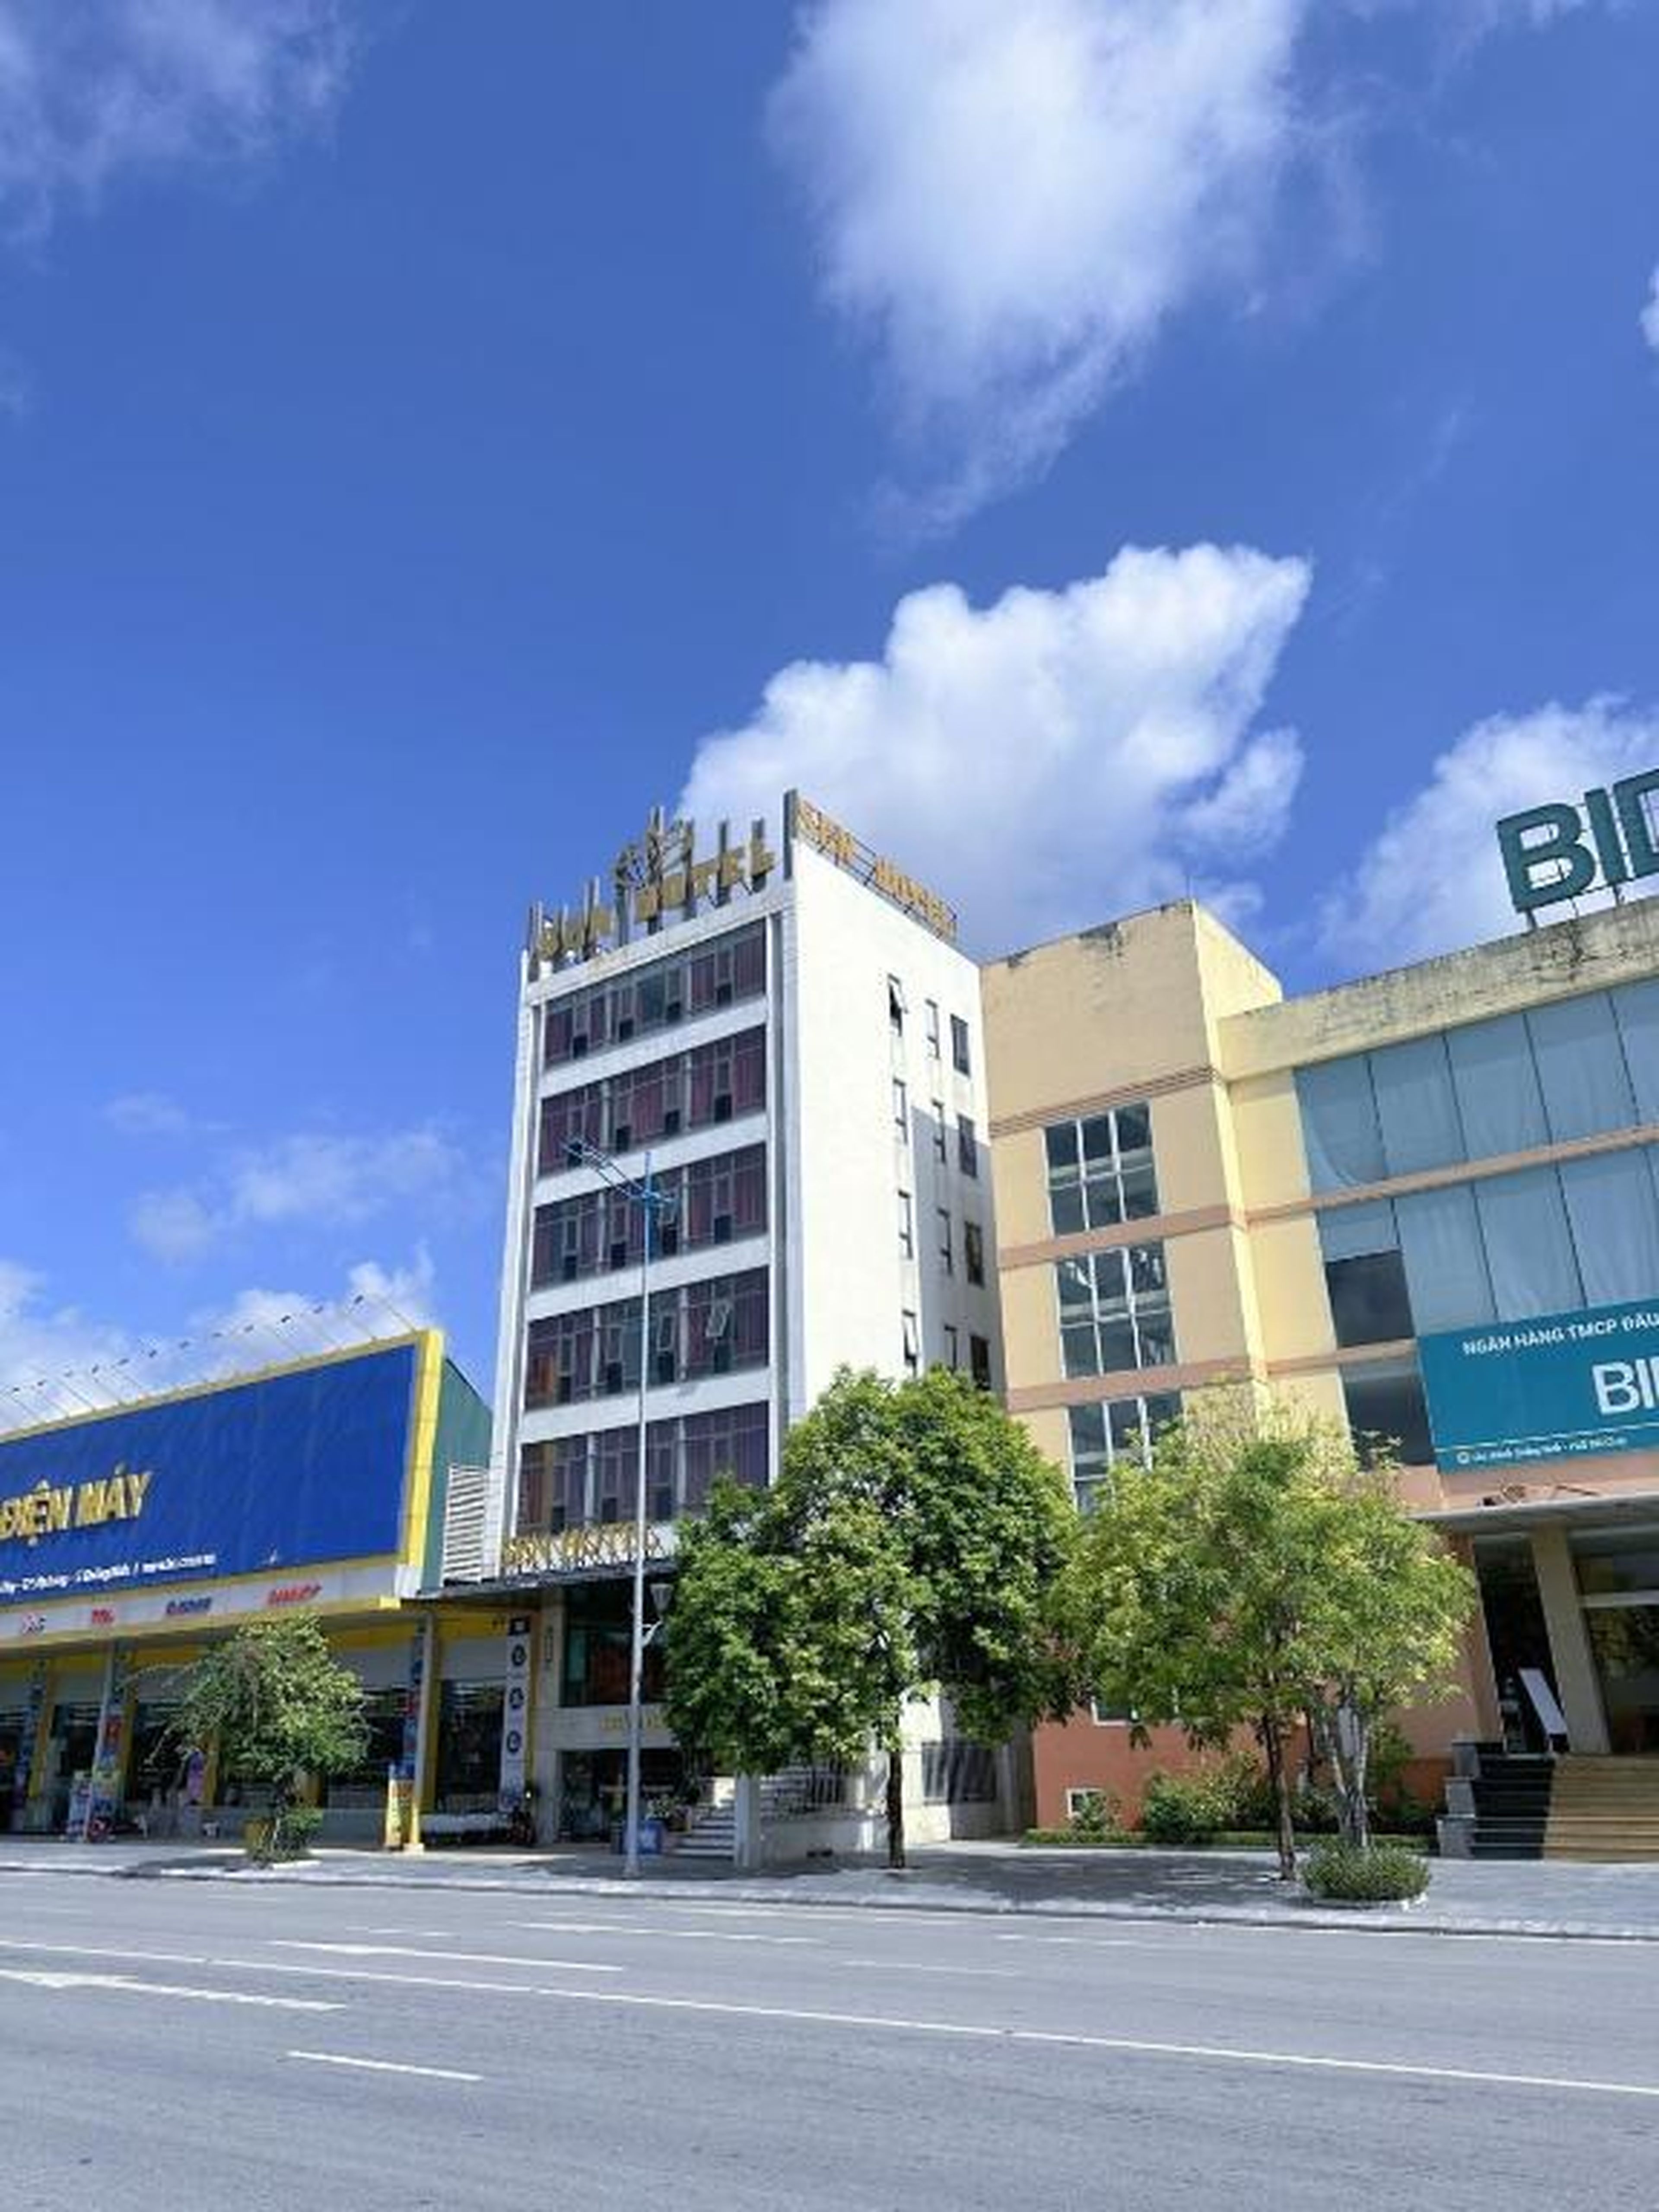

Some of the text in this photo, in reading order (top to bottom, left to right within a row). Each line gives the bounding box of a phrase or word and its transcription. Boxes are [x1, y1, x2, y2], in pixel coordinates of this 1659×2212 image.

[1567, 1318, 1617, 1339] TMCP
[1592, 1355, 1659, 1415] BI
[76, 1462, 153, 1527] MÁY
